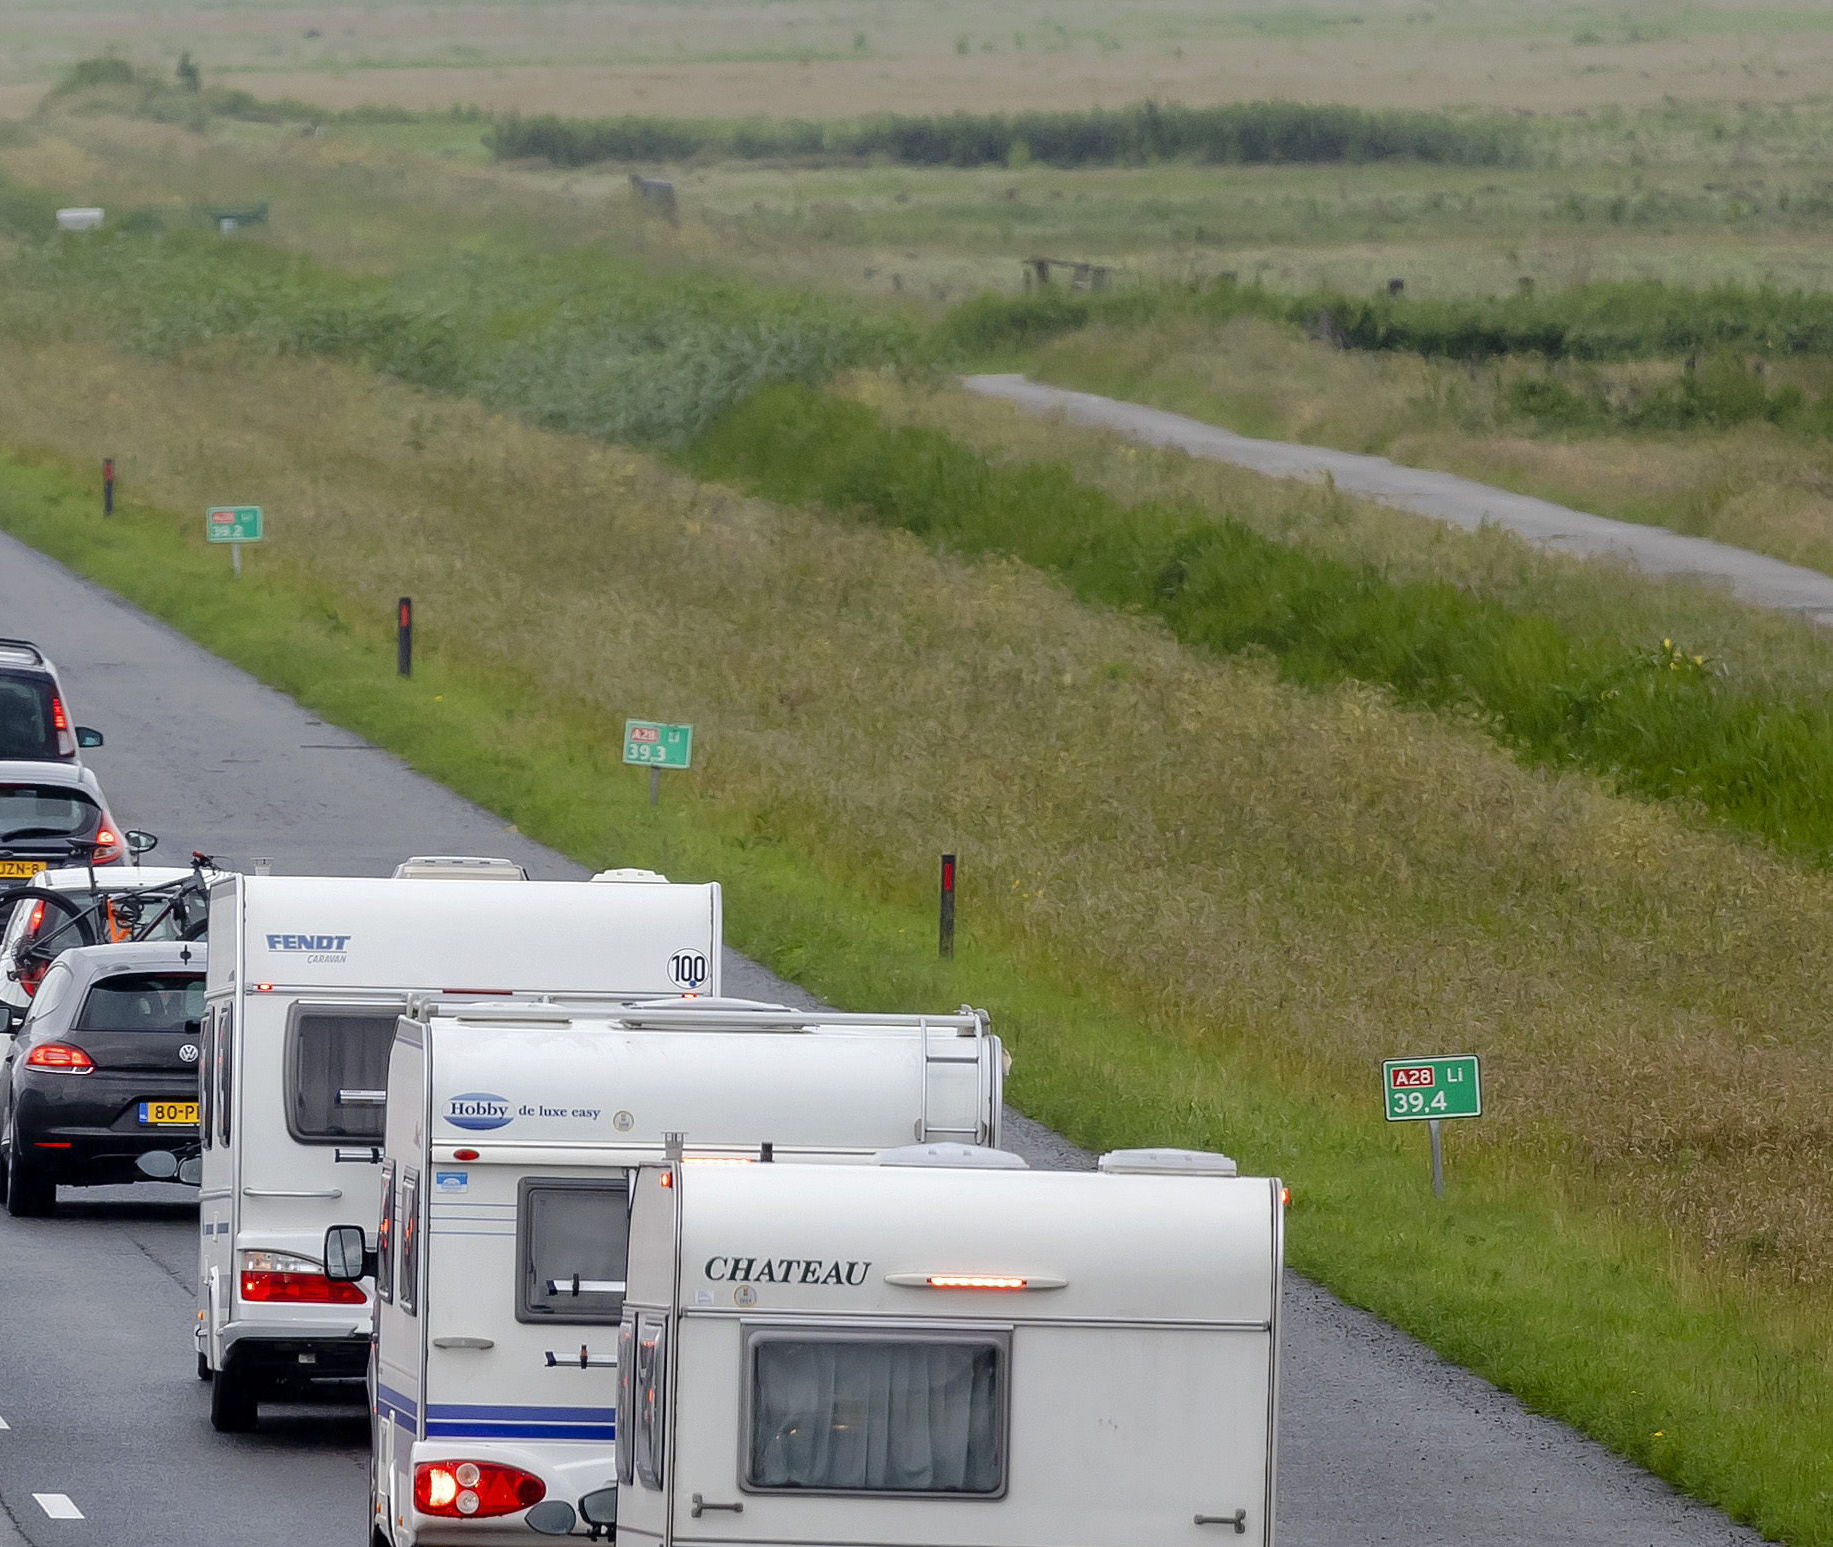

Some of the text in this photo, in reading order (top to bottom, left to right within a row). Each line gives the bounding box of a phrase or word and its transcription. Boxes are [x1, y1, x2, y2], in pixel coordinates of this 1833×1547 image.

[265, 934, 352, 950] FENDT
[307, 954, 347, 964] CARAVAN
[672, 955, 705, 982] 100
[1396, 1067, 1463, 1085] A28 Li
[450, 1102, 601, 1120] Hobby de luxe easy
[705, 1255, 873, 1286] CHATEAU
